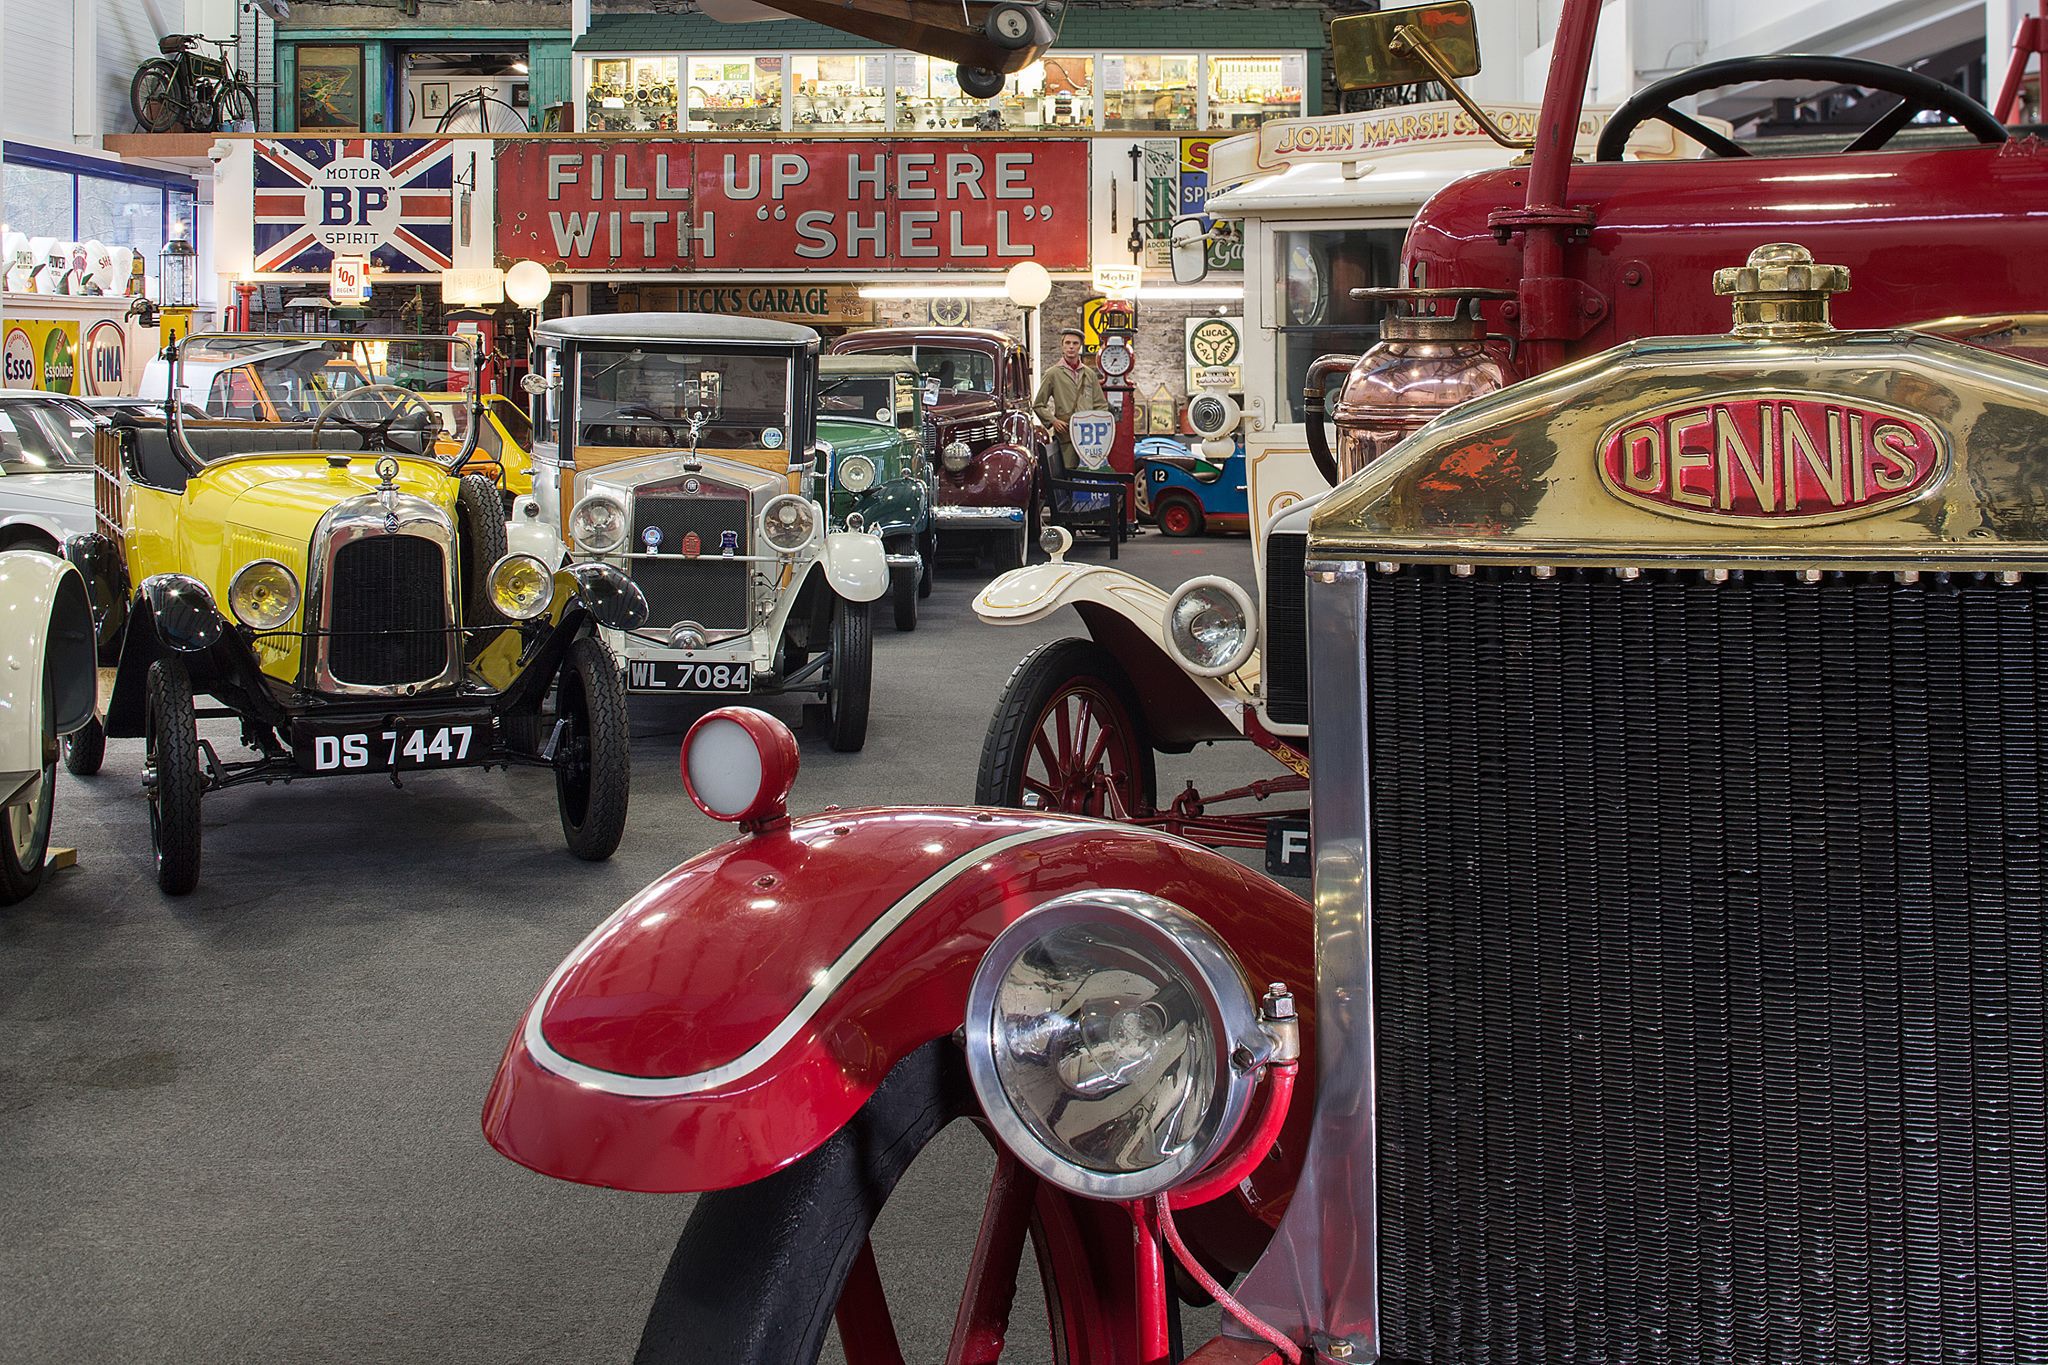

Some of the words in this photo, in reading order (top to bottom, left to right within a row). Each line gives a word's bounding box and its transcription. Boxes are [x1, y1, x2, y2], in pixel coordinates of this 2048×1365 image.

[1277, 123, 1354, 151] JOHN
[1363, 111, 1448, 145] MARSH
[326, 168, 380, 180] MOTOR
[548, 153, 691, 200] FILL
[723, 153, 810, 200] UP
[848, 153, 1033, 200] HERE
[325, 233, 379, 244] SPIRIT
[548, 210, 715, 258] WITH
[337, 266, 355, 287] 100
[1100, 273, 1135, 281] Mobil
[677, 288, 742, 314] LECK'S
[747, 288, 829, 315] GARAGE
[1201, 329, 1228, 337] LUCAS
[1196, 342, 1212, 361] CAV
[1217, 339, 1235, 362] ROTAX
[5, 352, 33, 380] Esso
[96, 346, 122, 382] FINA
[1084, 448, 1103, 456] PLUS
[1621, 403, 1918, 512] DENNIS
[1154, 470, 1166, 481] 12
[631, 663, 666, 687] WL
[677, 664, 748, 689] 7084
[315, 733, 369, 770] DS
[382, 726, 473, 765] 7447
